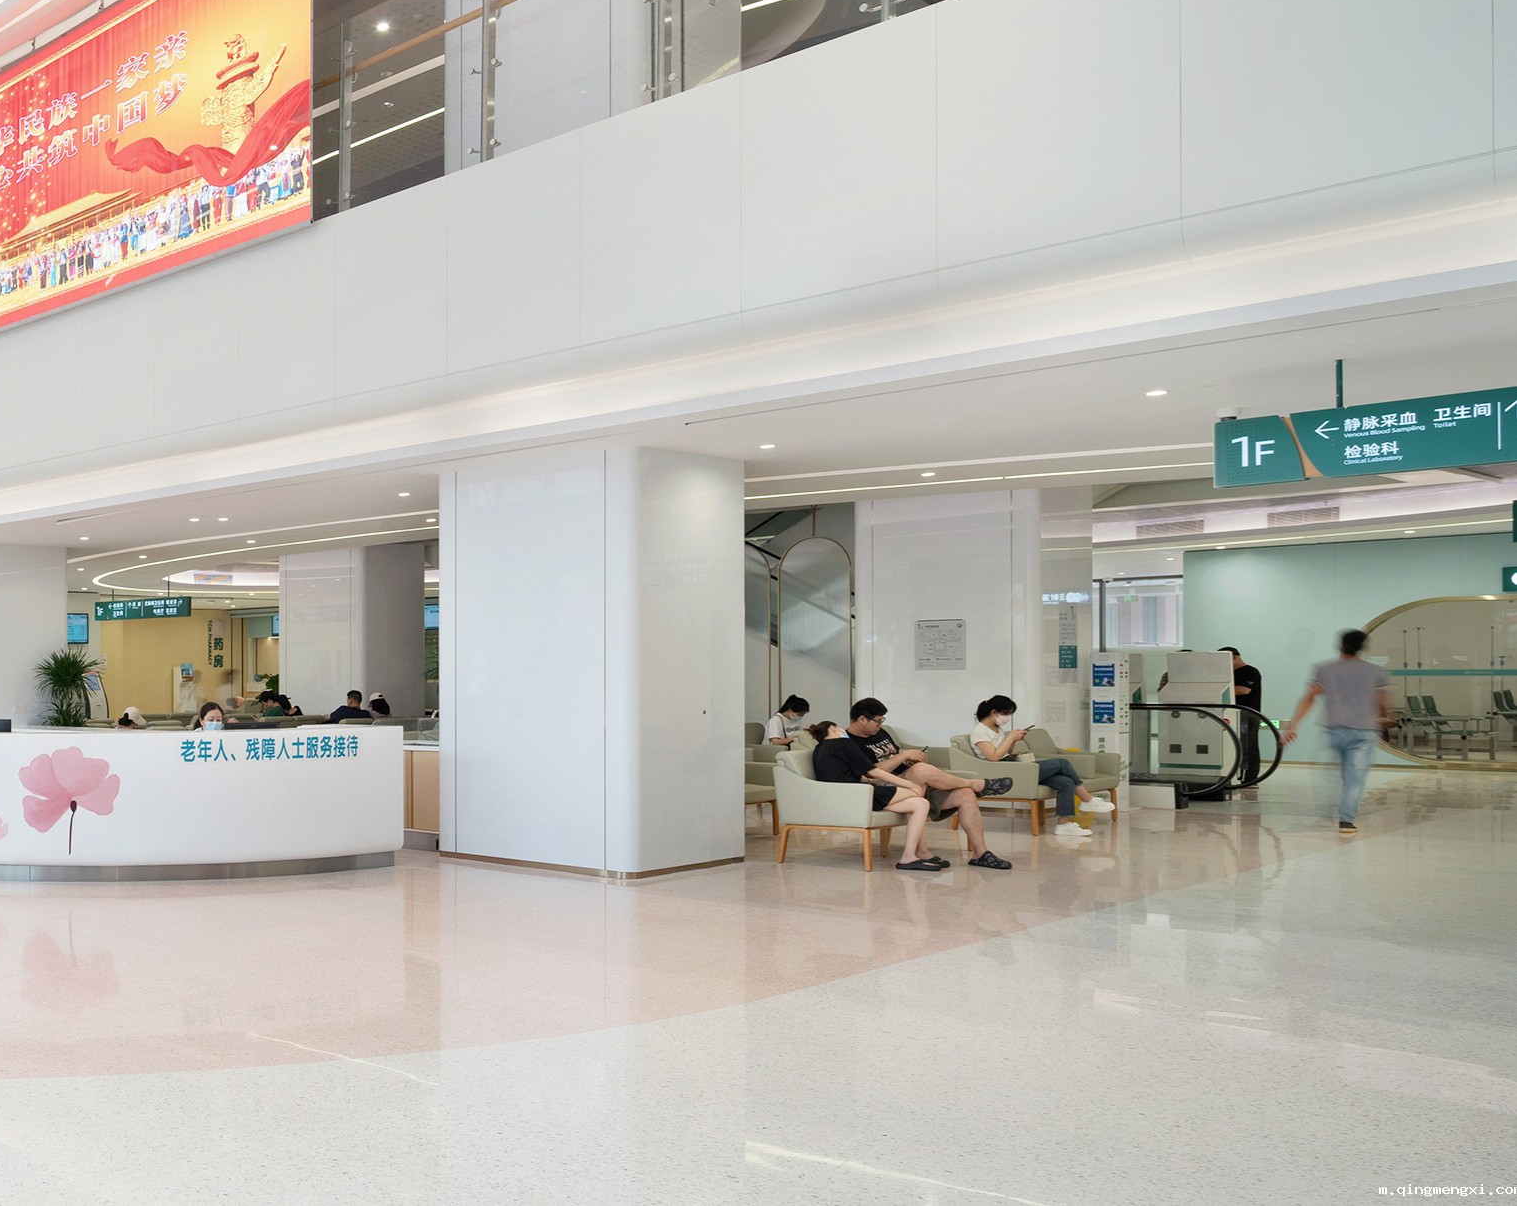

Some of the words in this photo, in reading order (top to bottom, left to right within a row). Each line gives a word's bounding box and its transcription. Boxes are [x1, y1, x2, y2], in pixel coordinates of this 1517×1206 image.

[1344, 411, 1417, 432] 静脉采血
[1433, 403, 1491, 422] 卫生间
[1434, 421, 1456, 429] Toilet
[1370, 427, 1390, 436] Blood
[1392, 424, 1425, 434] Sampling
[1231, 436, 1275, 467] 1F
[1344, 441, 1399, 459] 检验科
[1368, 455, 1403, 463] Laboratory
[214, 637, 223, 667] 药房
[180, 735, 358, 763] 老年人、残障人士服务接待
